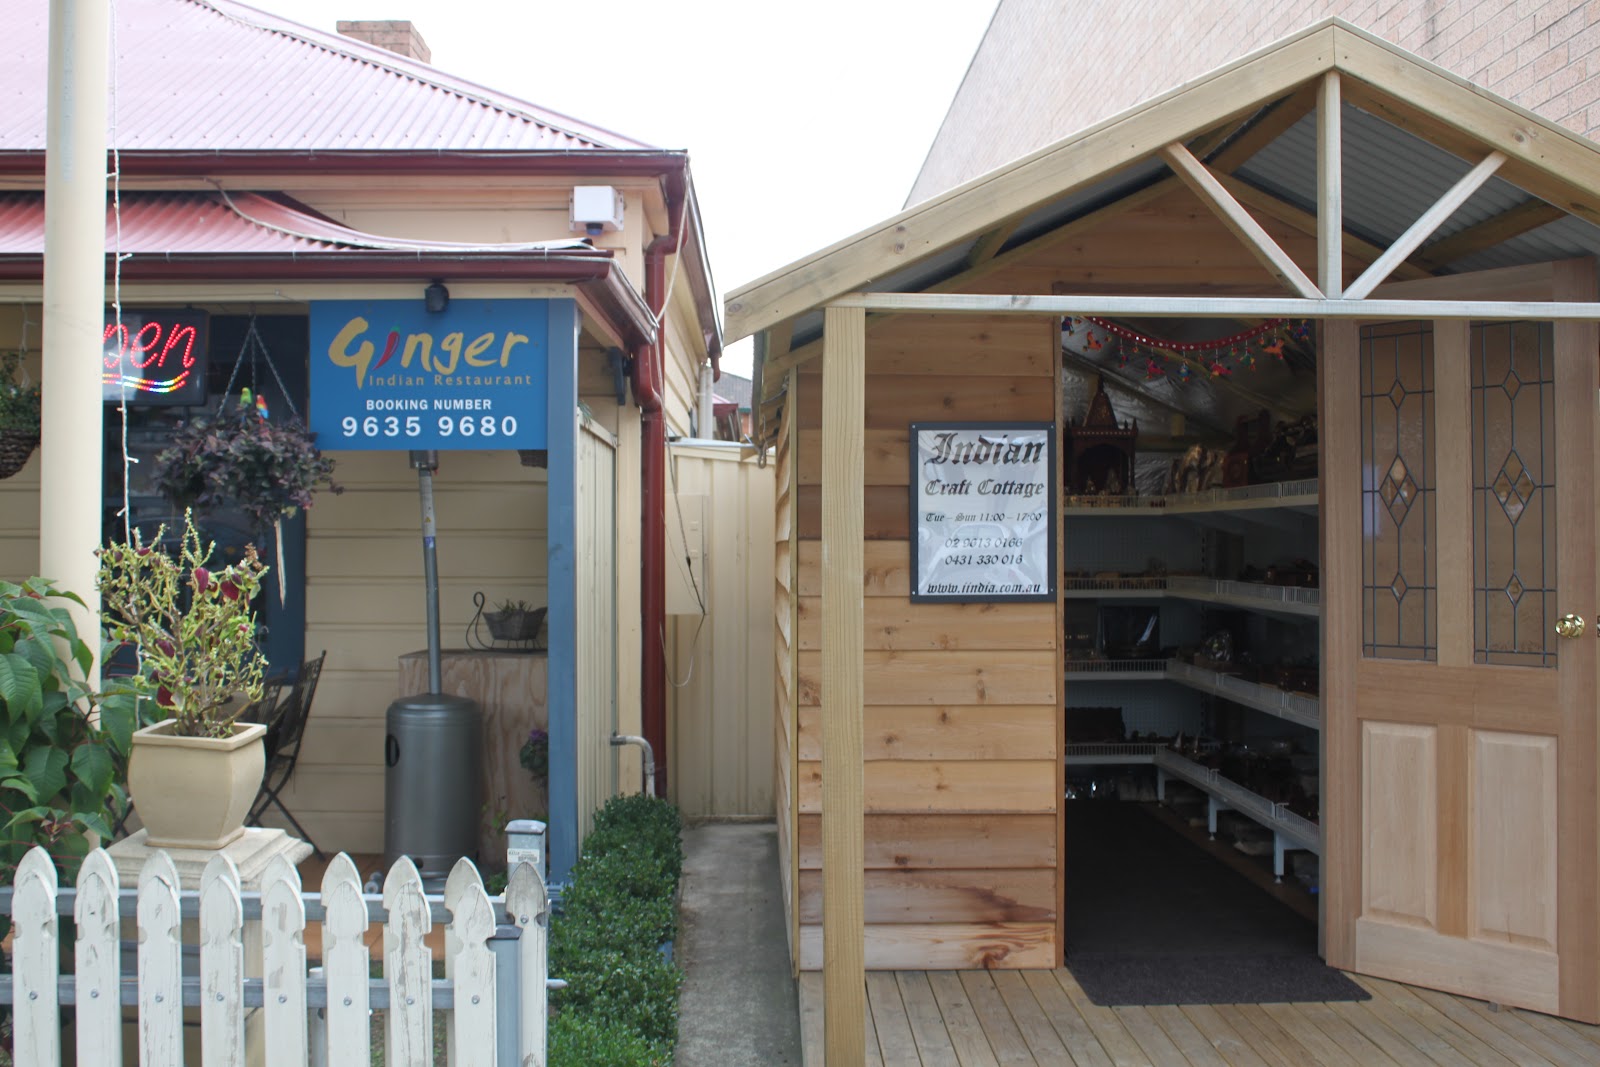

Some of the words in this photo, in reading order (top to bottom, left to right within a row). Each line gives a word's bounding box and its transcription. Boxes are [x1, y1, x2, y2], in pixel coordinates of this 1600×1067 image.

[102, 321, 196, 368] pen
[328, 316, 529, 390] Ginger
[369, 374, 424, 386] Indian
[434, 374, 532, 386] Restaurant
[366, 399, 429, 410] BOOKING
[433, 399, 492, 410] NUMBER
[342, 416, 421, 437] 9635
[438, 416, 518, 437] 9680
[924, 432, 1045, 466] Indian
[925, 479, 972, 496] Craft
[977, 479, 1045, 498] Cottage
[925, 512, 945, 522] Tue
[954, 512, 976, 522] Sun
[979, 512, 1005, 522] 11:00
[1016, 512, 1042, 522] 17:00
[944, 537, 960, 548] 02
[944, 554, 972, 565] 0431
[976, 554, 999, 565] 330
[926, 581, 1041, 594] www.iindia.com.au
